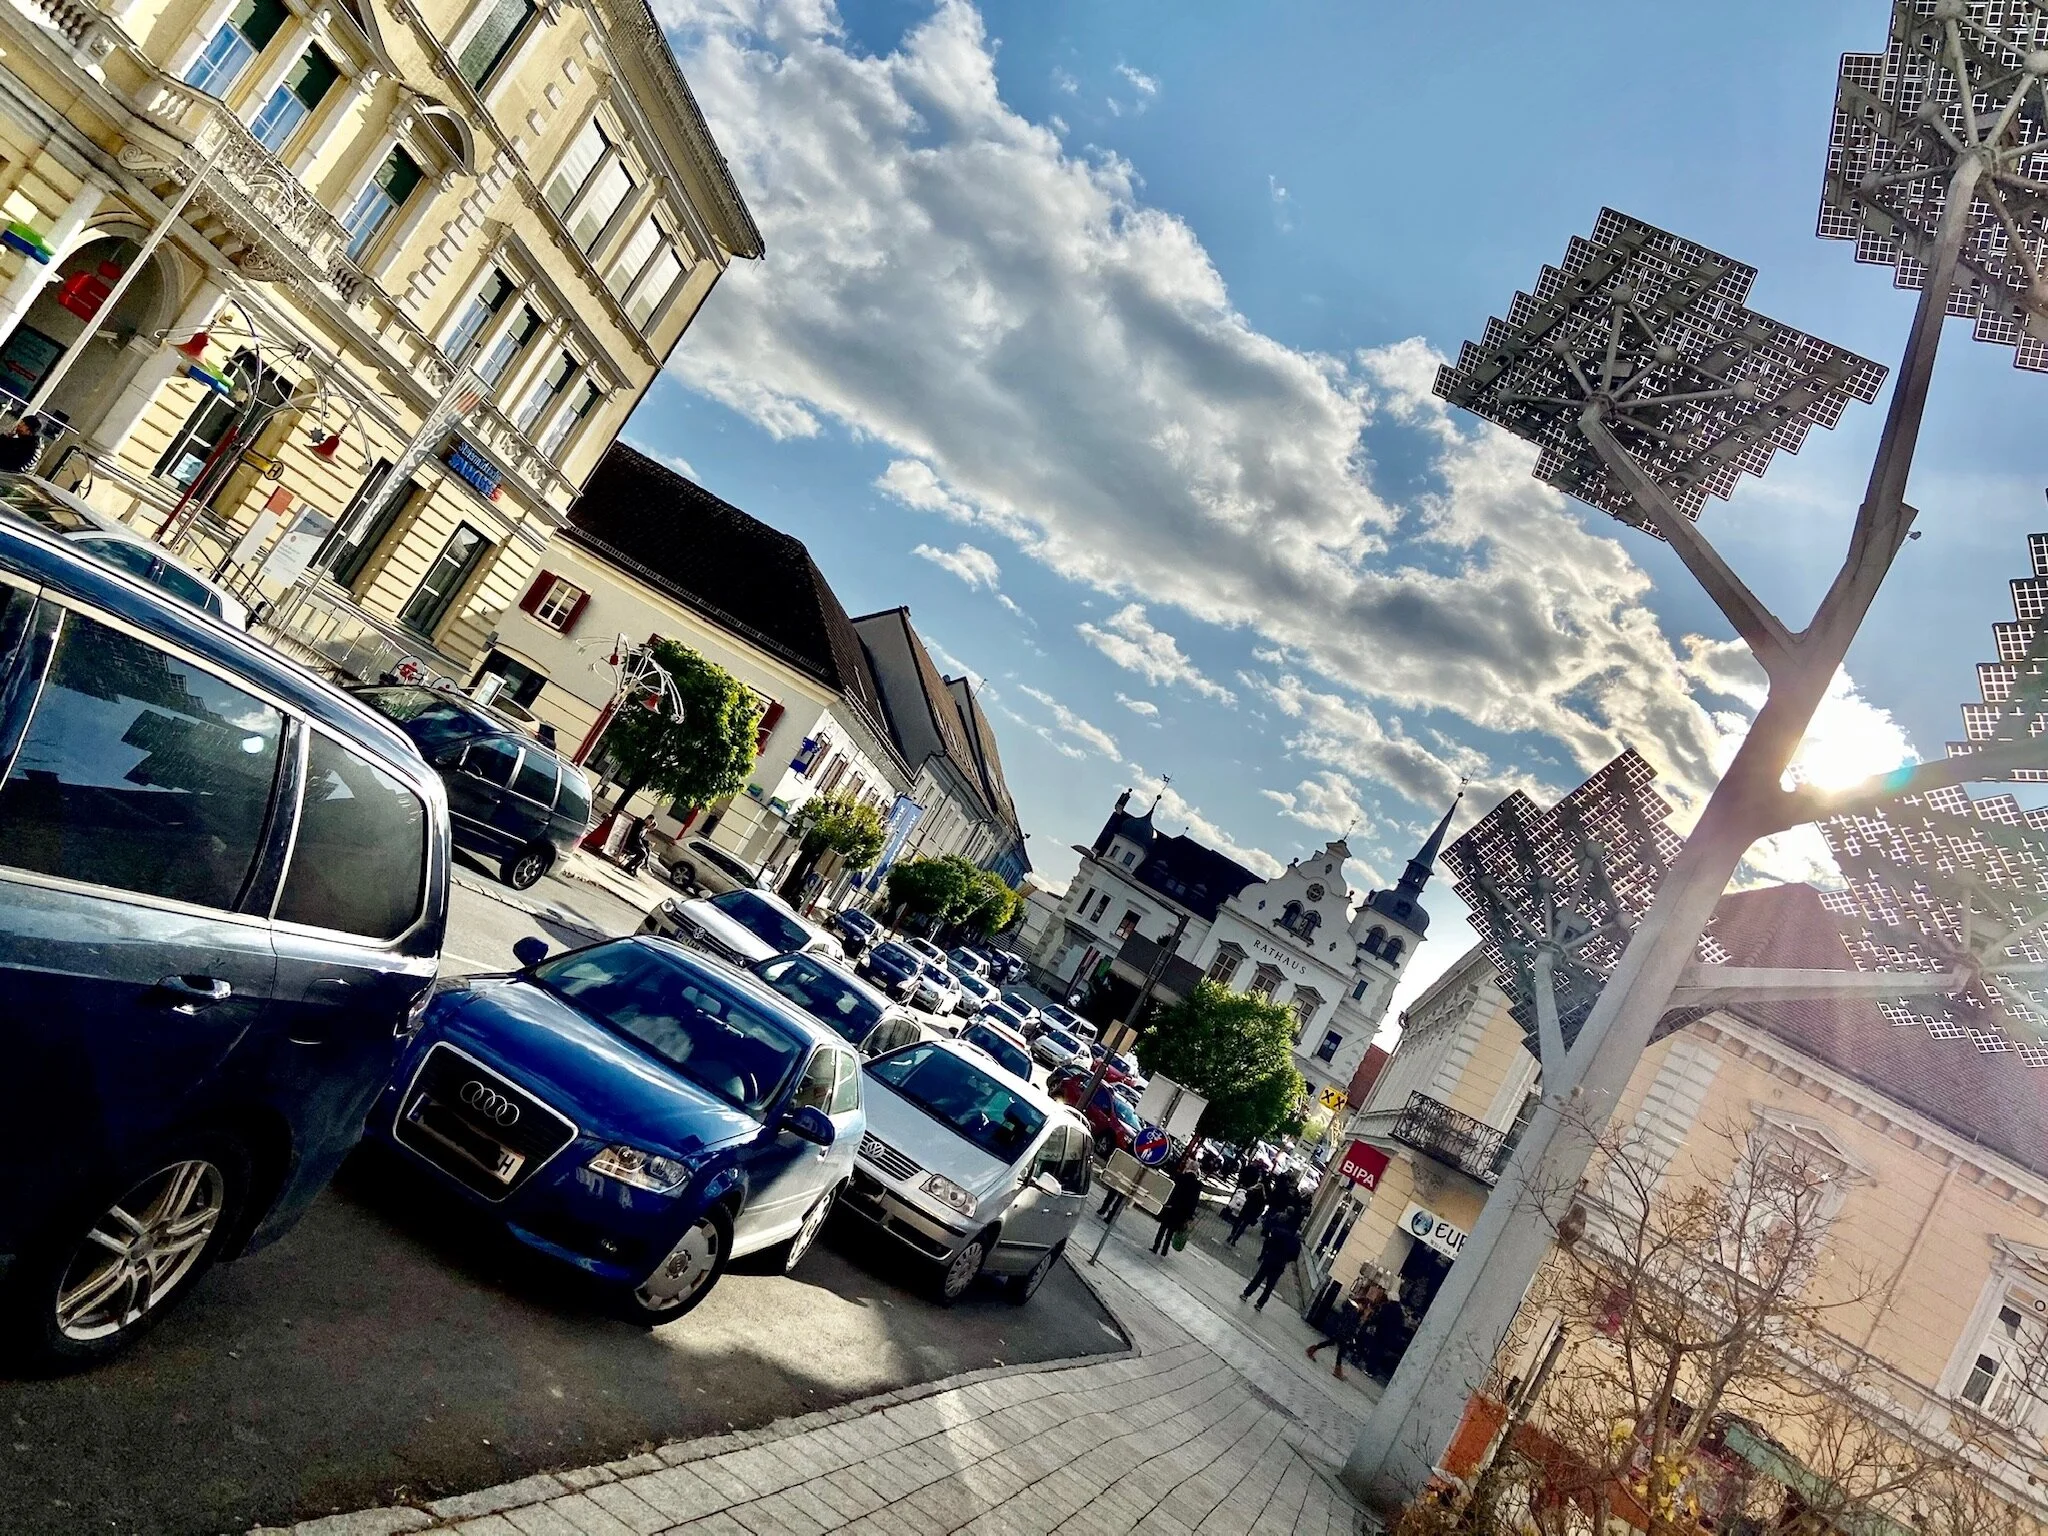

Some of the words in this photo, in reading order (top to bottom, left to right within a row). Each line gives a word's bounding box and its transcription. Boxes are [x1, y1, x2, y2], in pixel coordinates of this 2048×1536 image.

[267, 463, 282, 477] H
[1253, 939, 1306, 974] RATHAUS
[1342, 1159, 1375, 1187] BIPA
